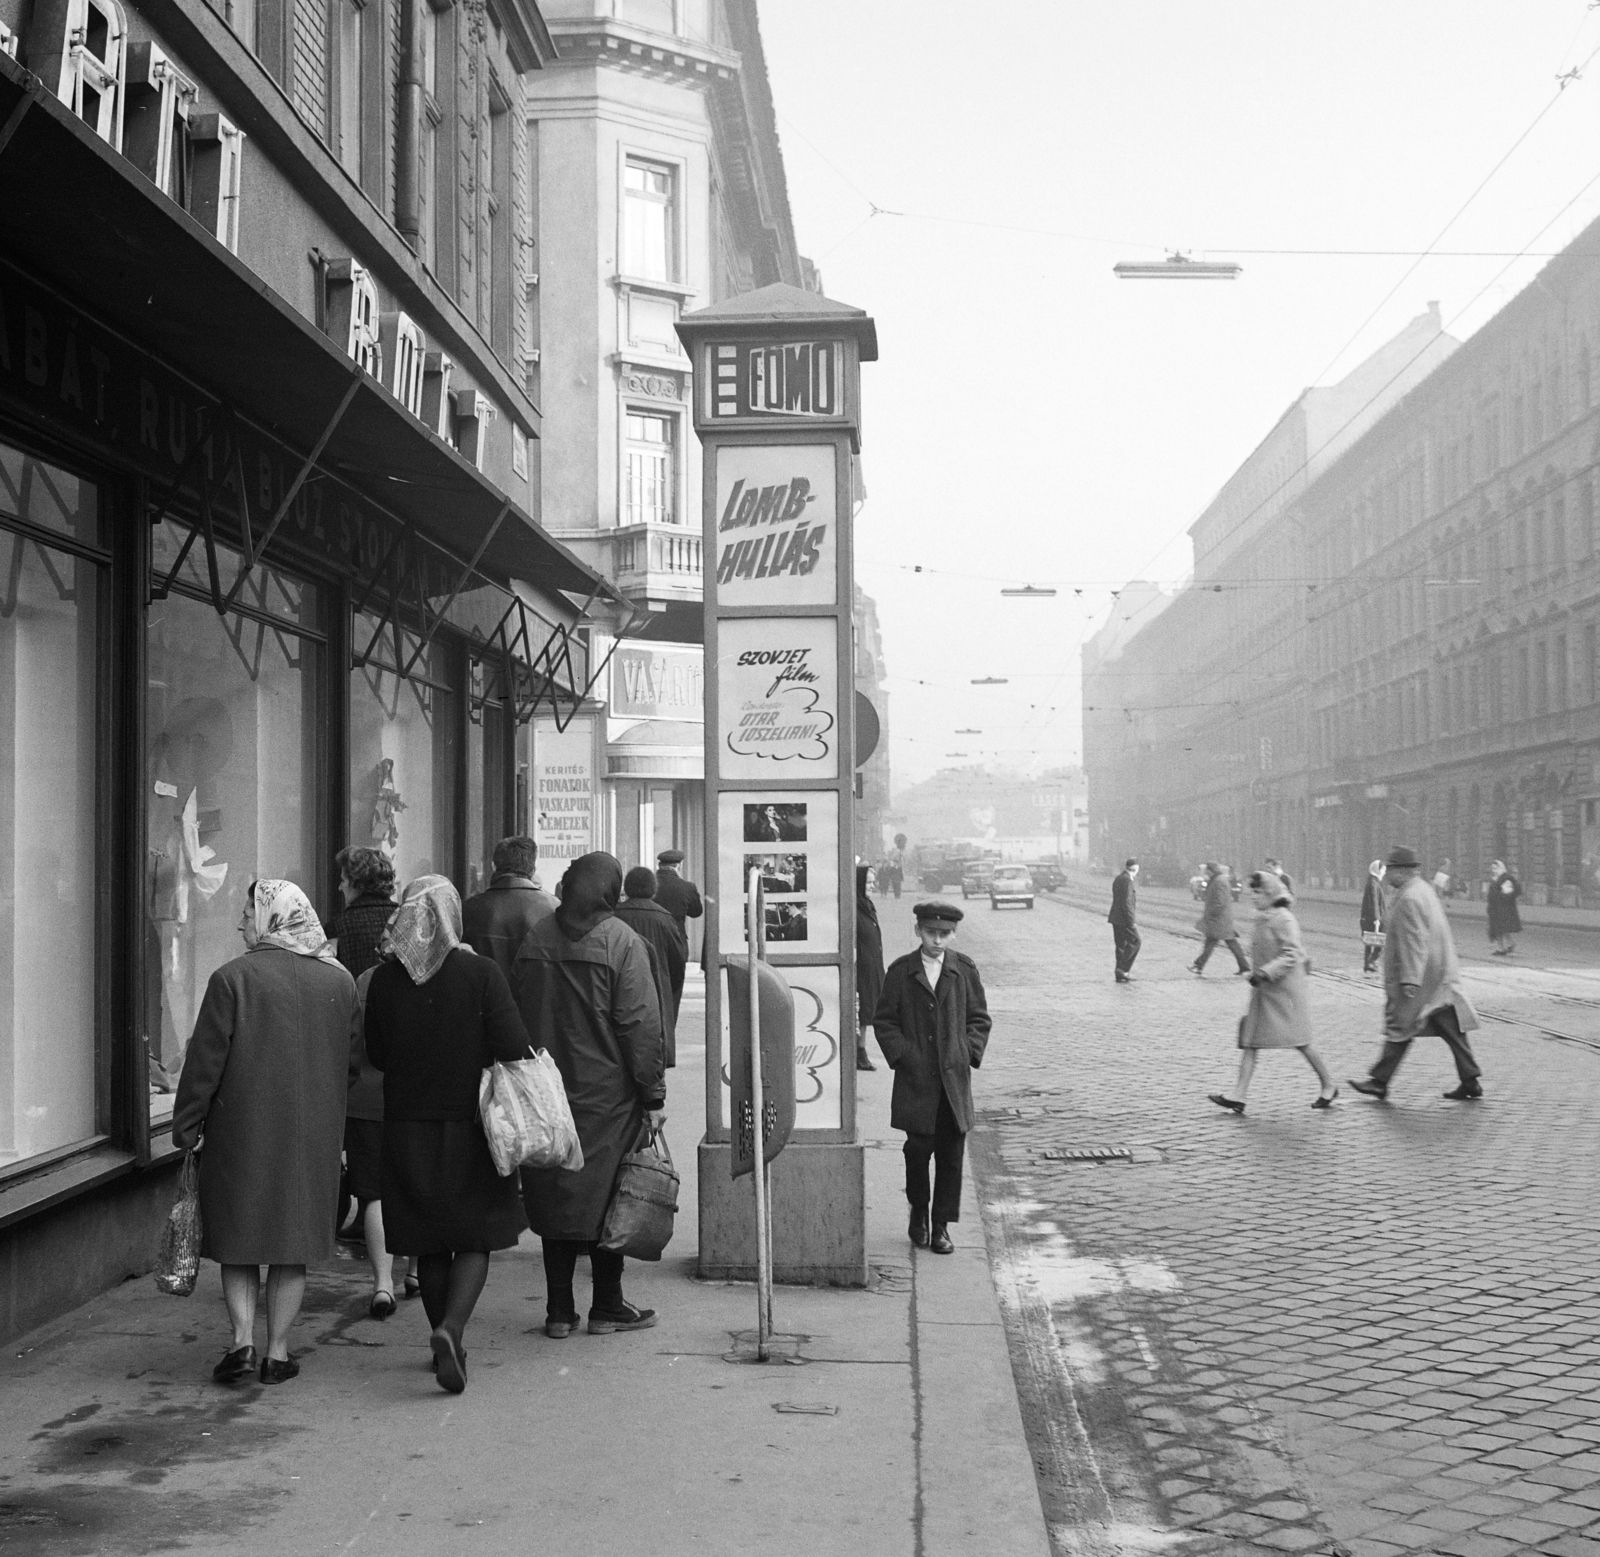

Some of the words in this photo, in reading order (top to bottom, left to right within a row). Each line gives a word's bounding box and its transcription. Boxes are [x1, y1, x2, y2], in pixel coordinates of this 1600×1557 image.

[718, 476, 818, 533] LOMB-
[716, 520, 827, 585] HULLÁS
[737, 648, 812, 666] SZOVJET
[765, 663, 820, 698] film
[738, 711, 780, 727] OTAR
[538, 778, 590, 792] FONATOK
[538, 797, 590, 811] VASKAPUK
[538, 816, 589, 830] LEMEZEK
